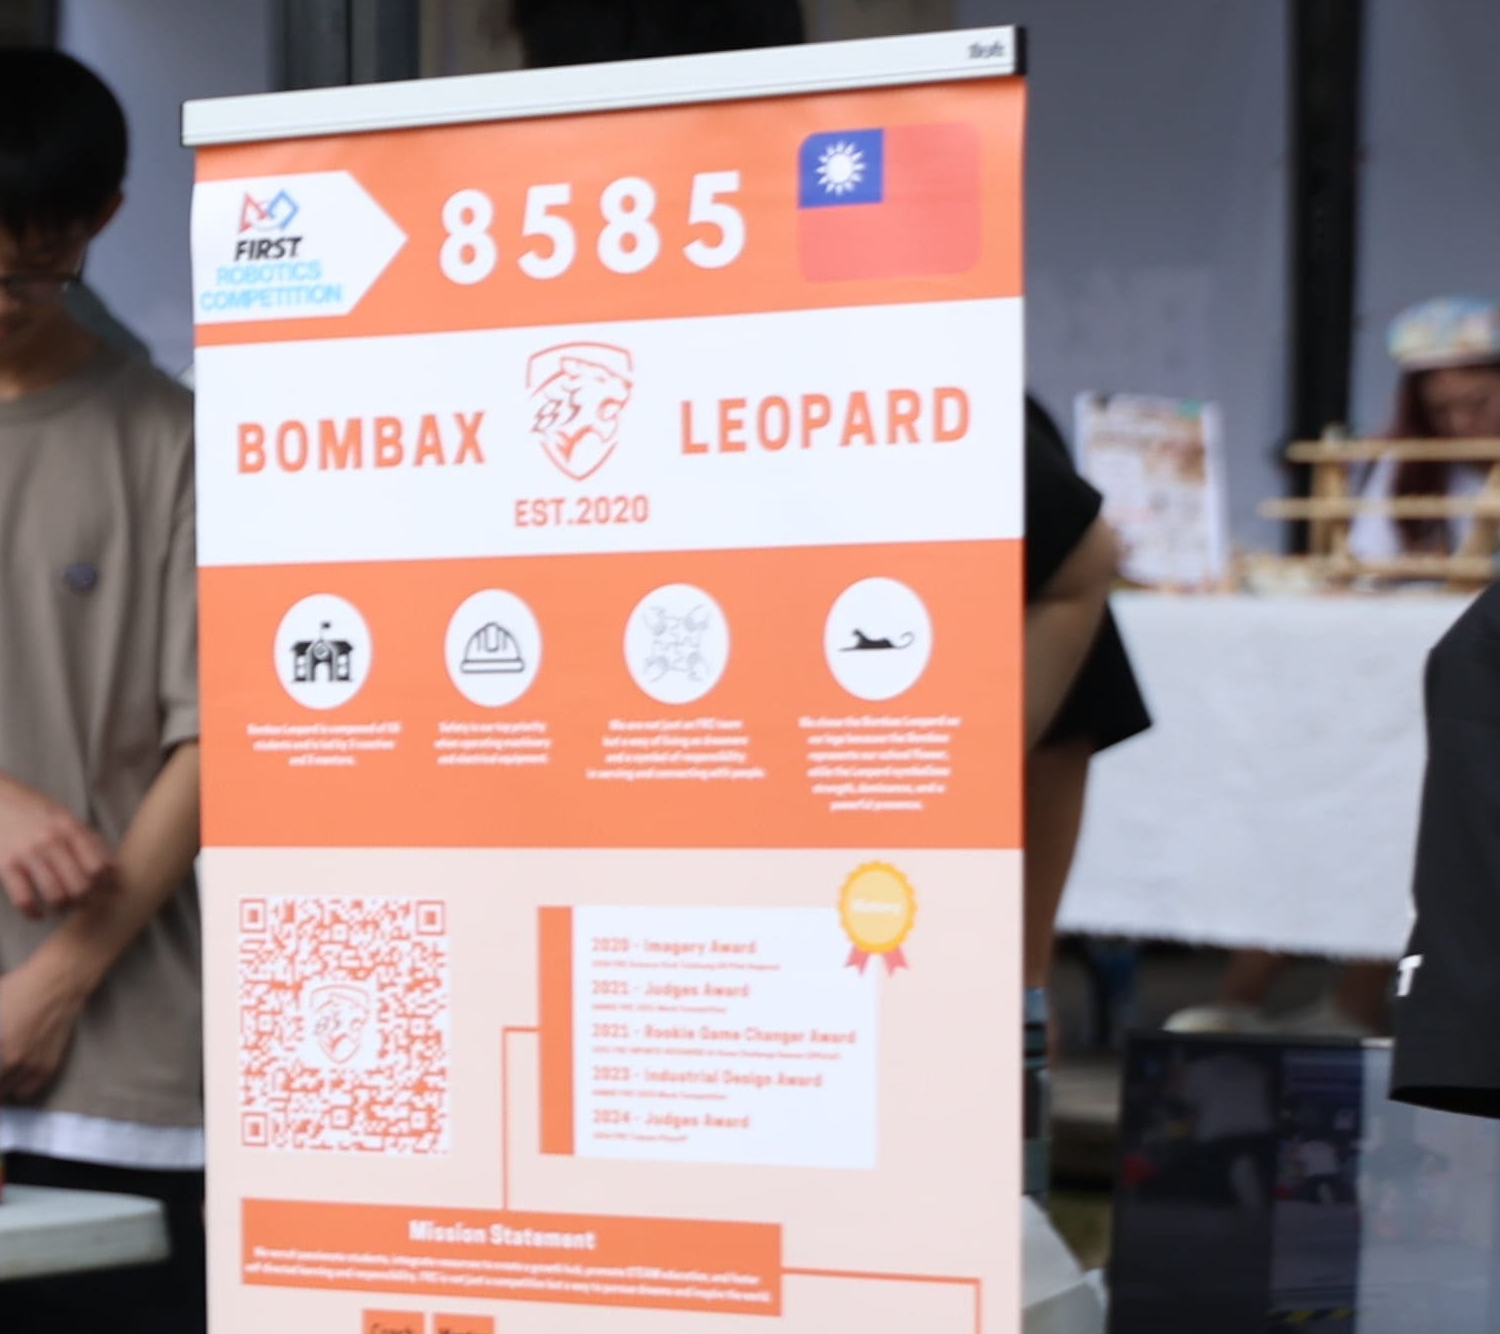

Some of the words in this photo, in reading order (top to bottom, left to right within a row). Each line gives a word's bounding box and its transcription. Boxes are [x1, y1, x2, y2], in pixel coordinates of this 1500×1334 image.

[440, 171, 747, 285] 8585
[235, 235, 303, 262] FIRST
[216, 261, 323, 287] ROBOTICS
[199, 282, 343, 311] COMPETITION
[236, 411, 487, 475] BOMBAX
[680, 386, 971, 455] LEOPARD
[514, 495, 650, 528] EST.2020
[409, 1220, 486, 1244] Mission
[490, 1224, 596, 1250] Statement
